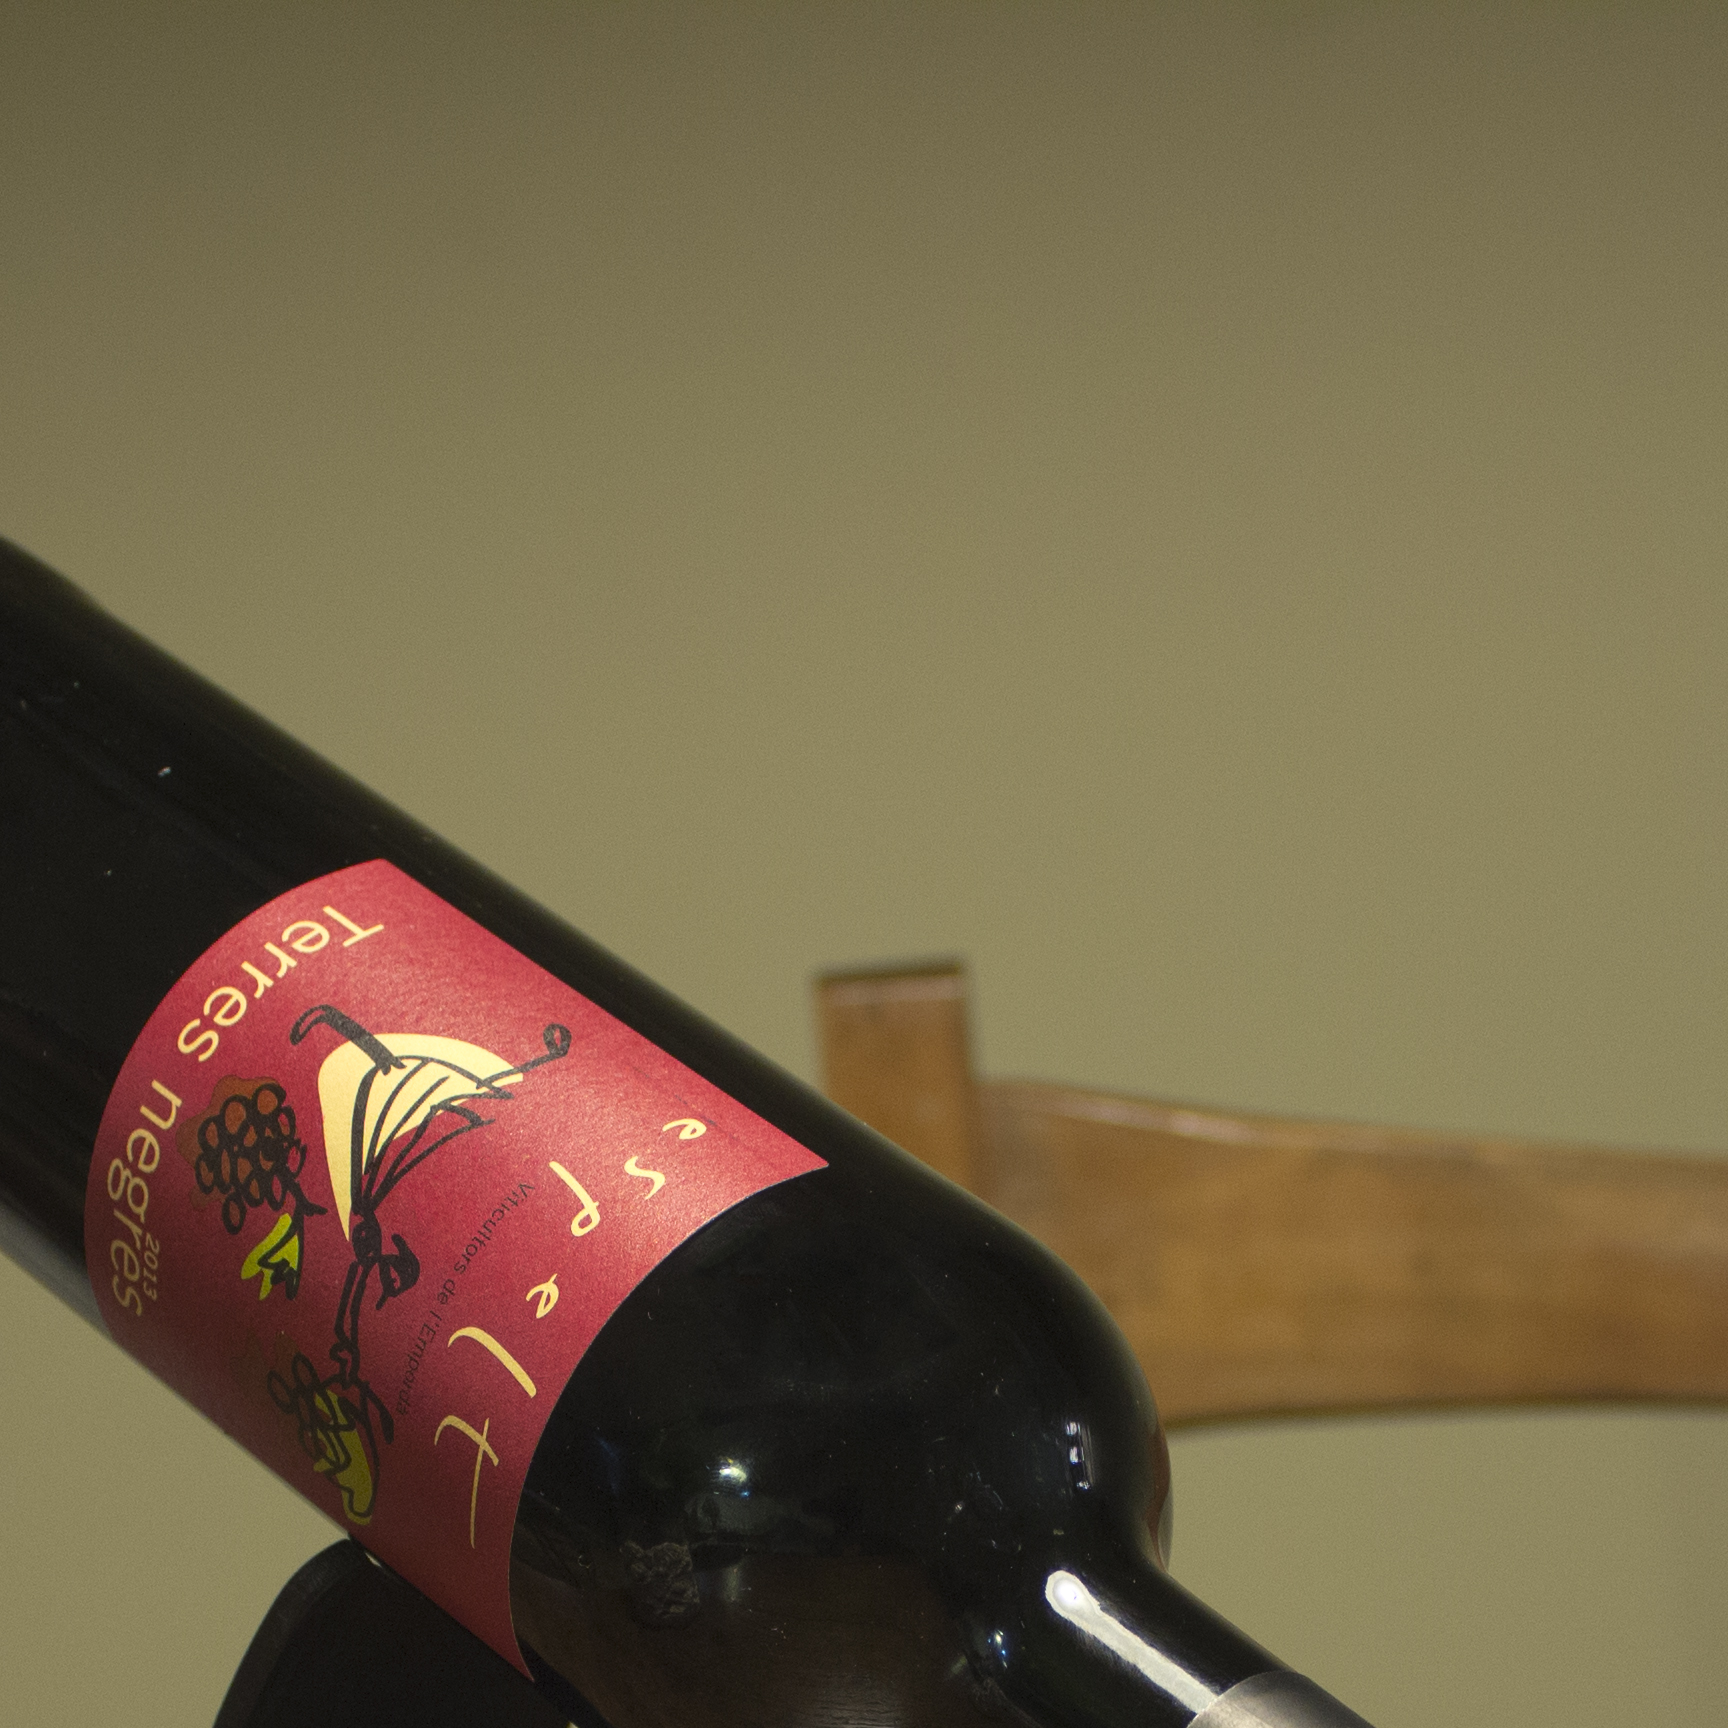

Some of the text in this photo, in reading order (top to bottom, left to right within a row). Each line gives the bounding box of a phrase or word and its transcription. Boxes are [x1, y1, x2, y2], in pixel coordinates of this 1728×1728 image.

[107, 905, 385, 1317] Terres negres
[143, 1232, 160, 1301] 2013
[454, 1182, 535, 1275] Viticultors
[434, 1118, 707, 1550] espelt
[437, 1279, 457, 1305] de
